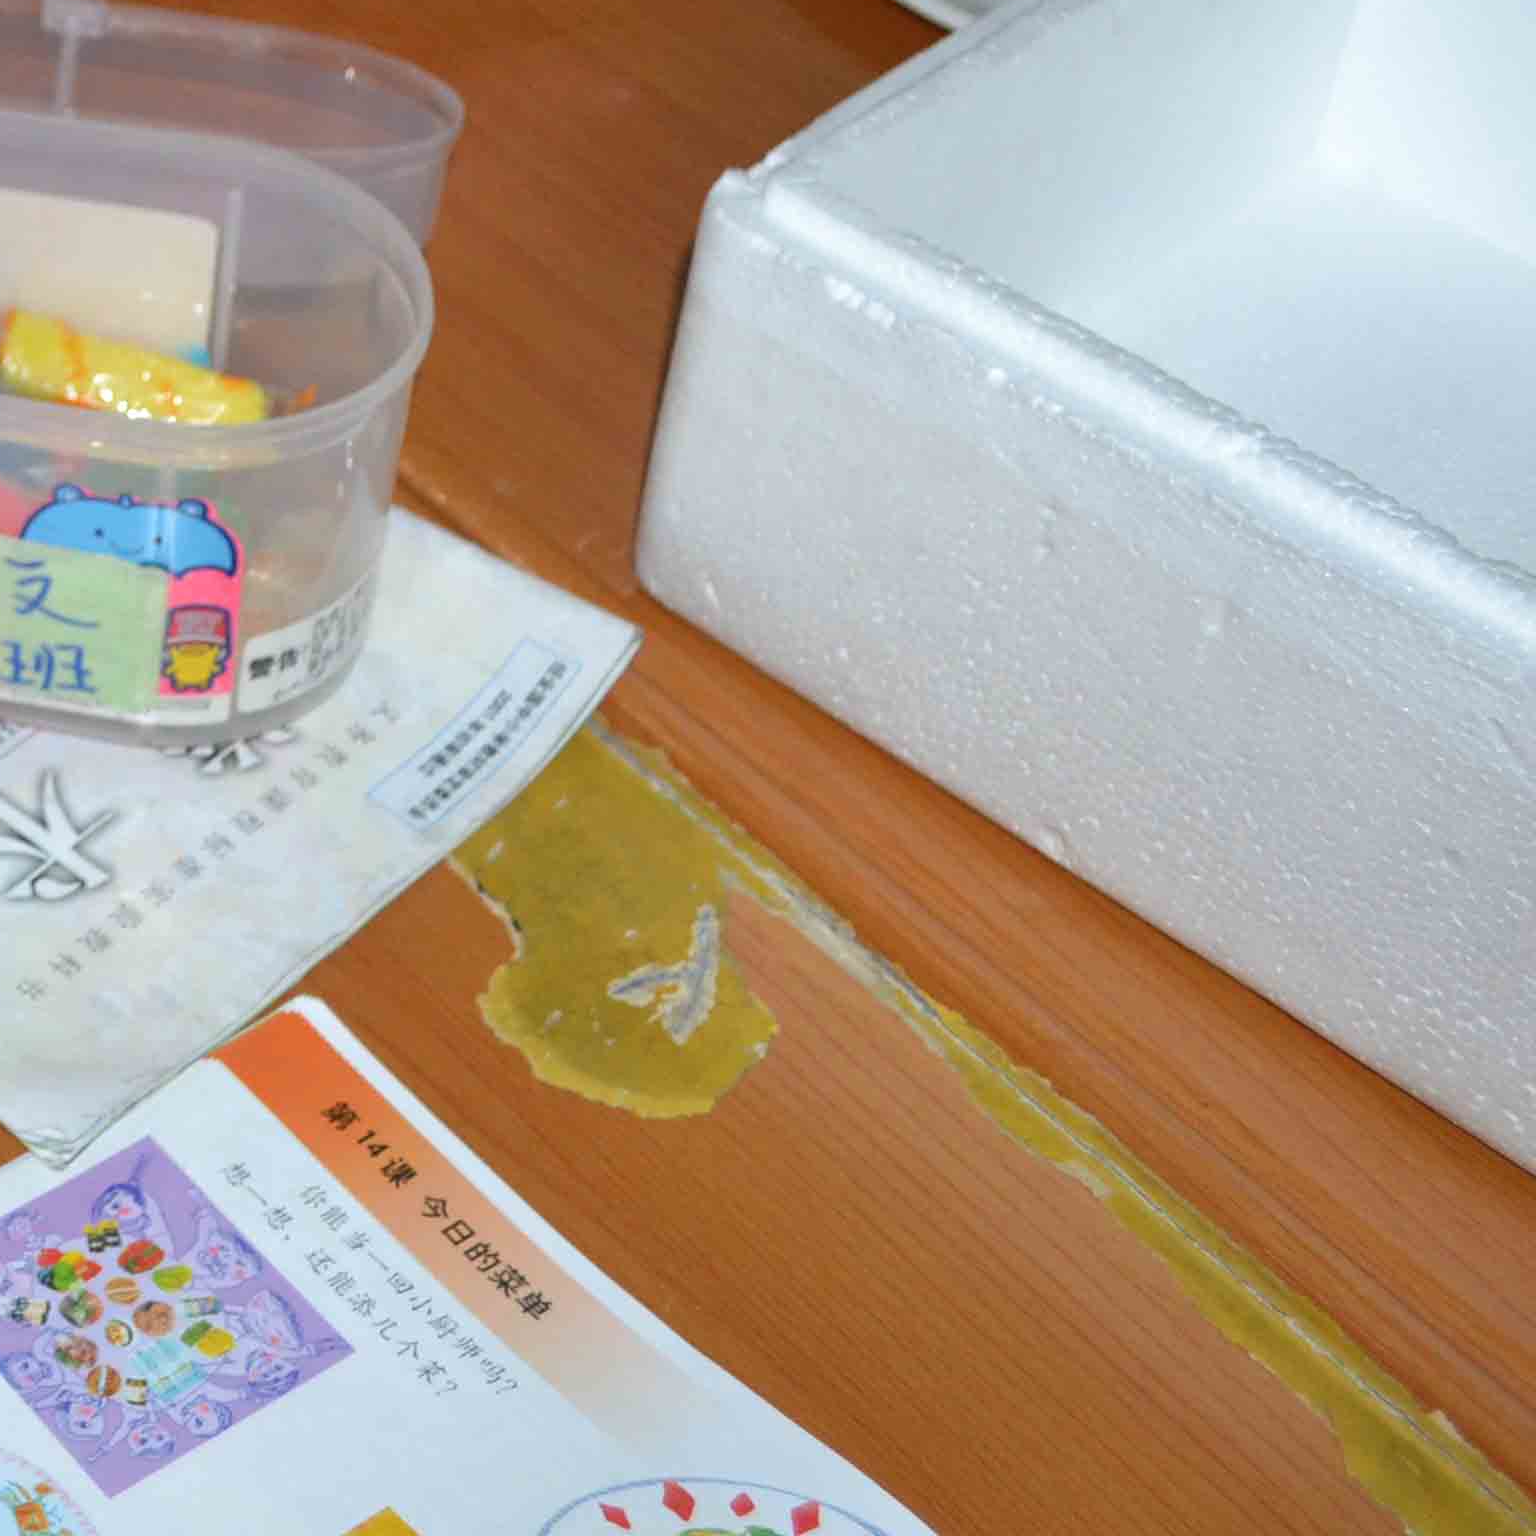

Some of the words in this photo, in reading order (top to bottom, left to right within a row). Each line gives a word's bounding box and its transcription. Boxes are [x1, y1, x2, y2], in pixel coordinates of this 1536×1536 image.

[421, 1195, 555, 1321] 今日的菜单
